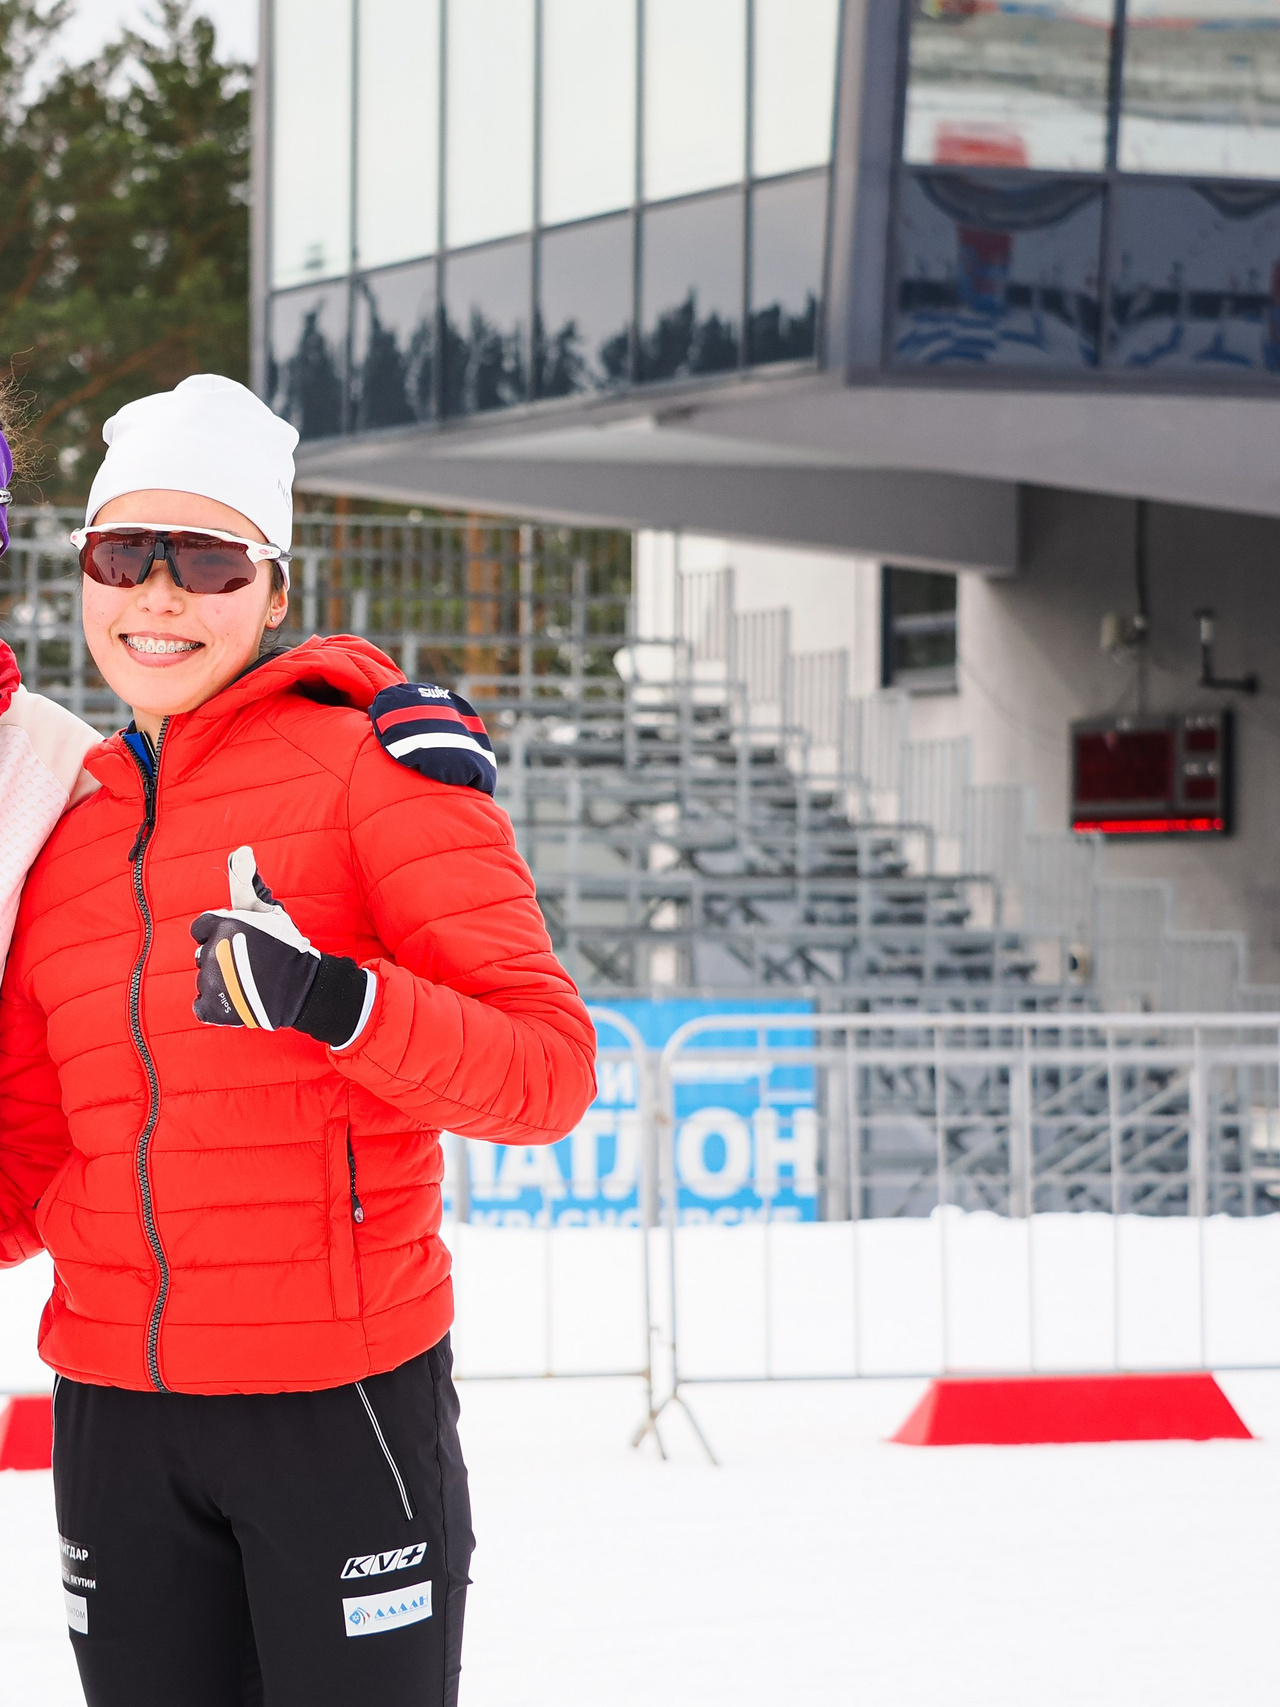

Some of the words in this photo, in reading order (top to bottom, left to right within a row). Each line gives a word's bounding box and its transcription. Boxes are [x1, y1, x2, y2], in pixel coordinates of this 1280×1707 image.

[218, 991, 232, 1014] Solid
[444, 1106, 818, 1199] АТЛОН
[70, 1574, 97, 1589] ЯКУТИИ
